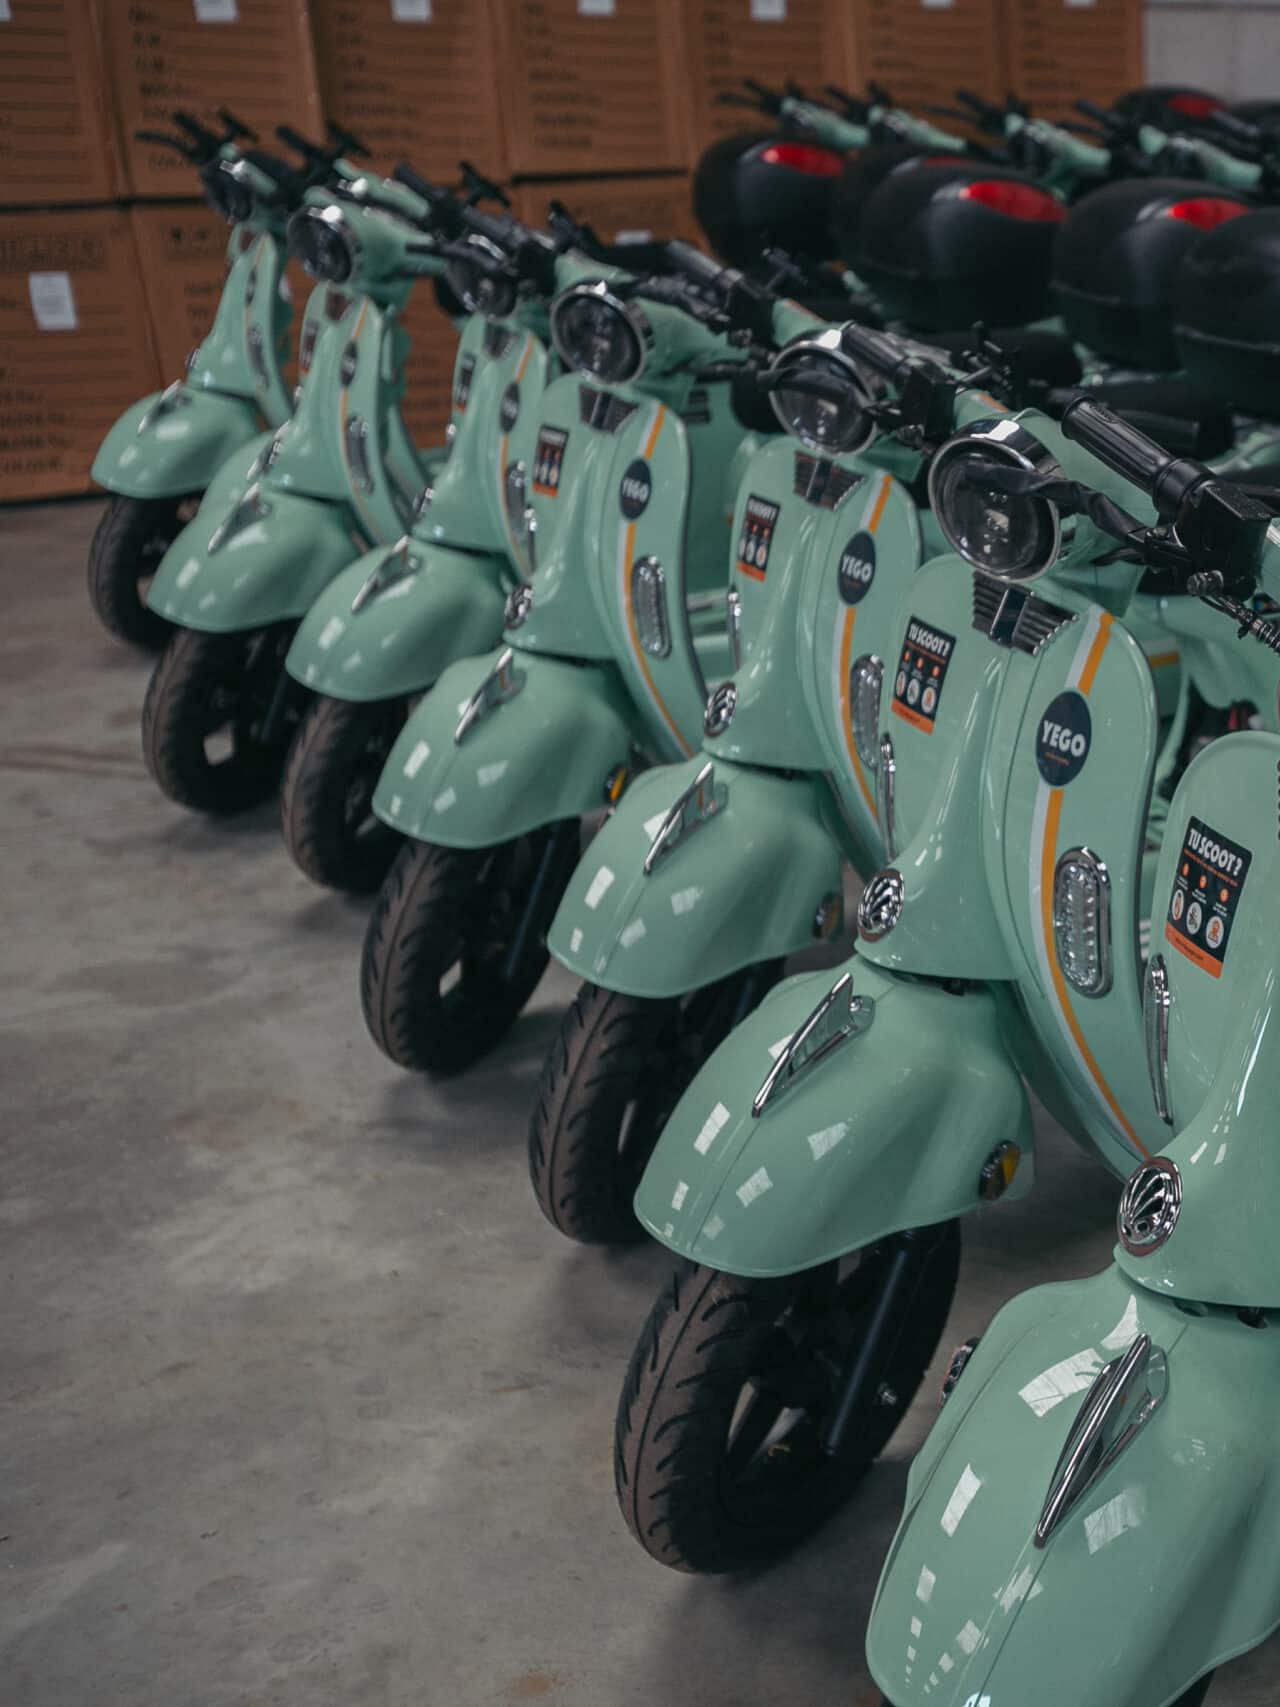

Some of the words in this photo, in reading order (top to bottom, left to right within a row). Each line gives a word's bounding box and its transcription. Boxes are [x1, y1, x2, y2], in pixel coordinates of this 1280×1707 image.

[841, 554, 873, 583] YEGO
[1041, 720, 1086, 757] YEGO
[1187, 828, 1202, 852] TU
[1199, 834, 1236, 874] SCOOT
